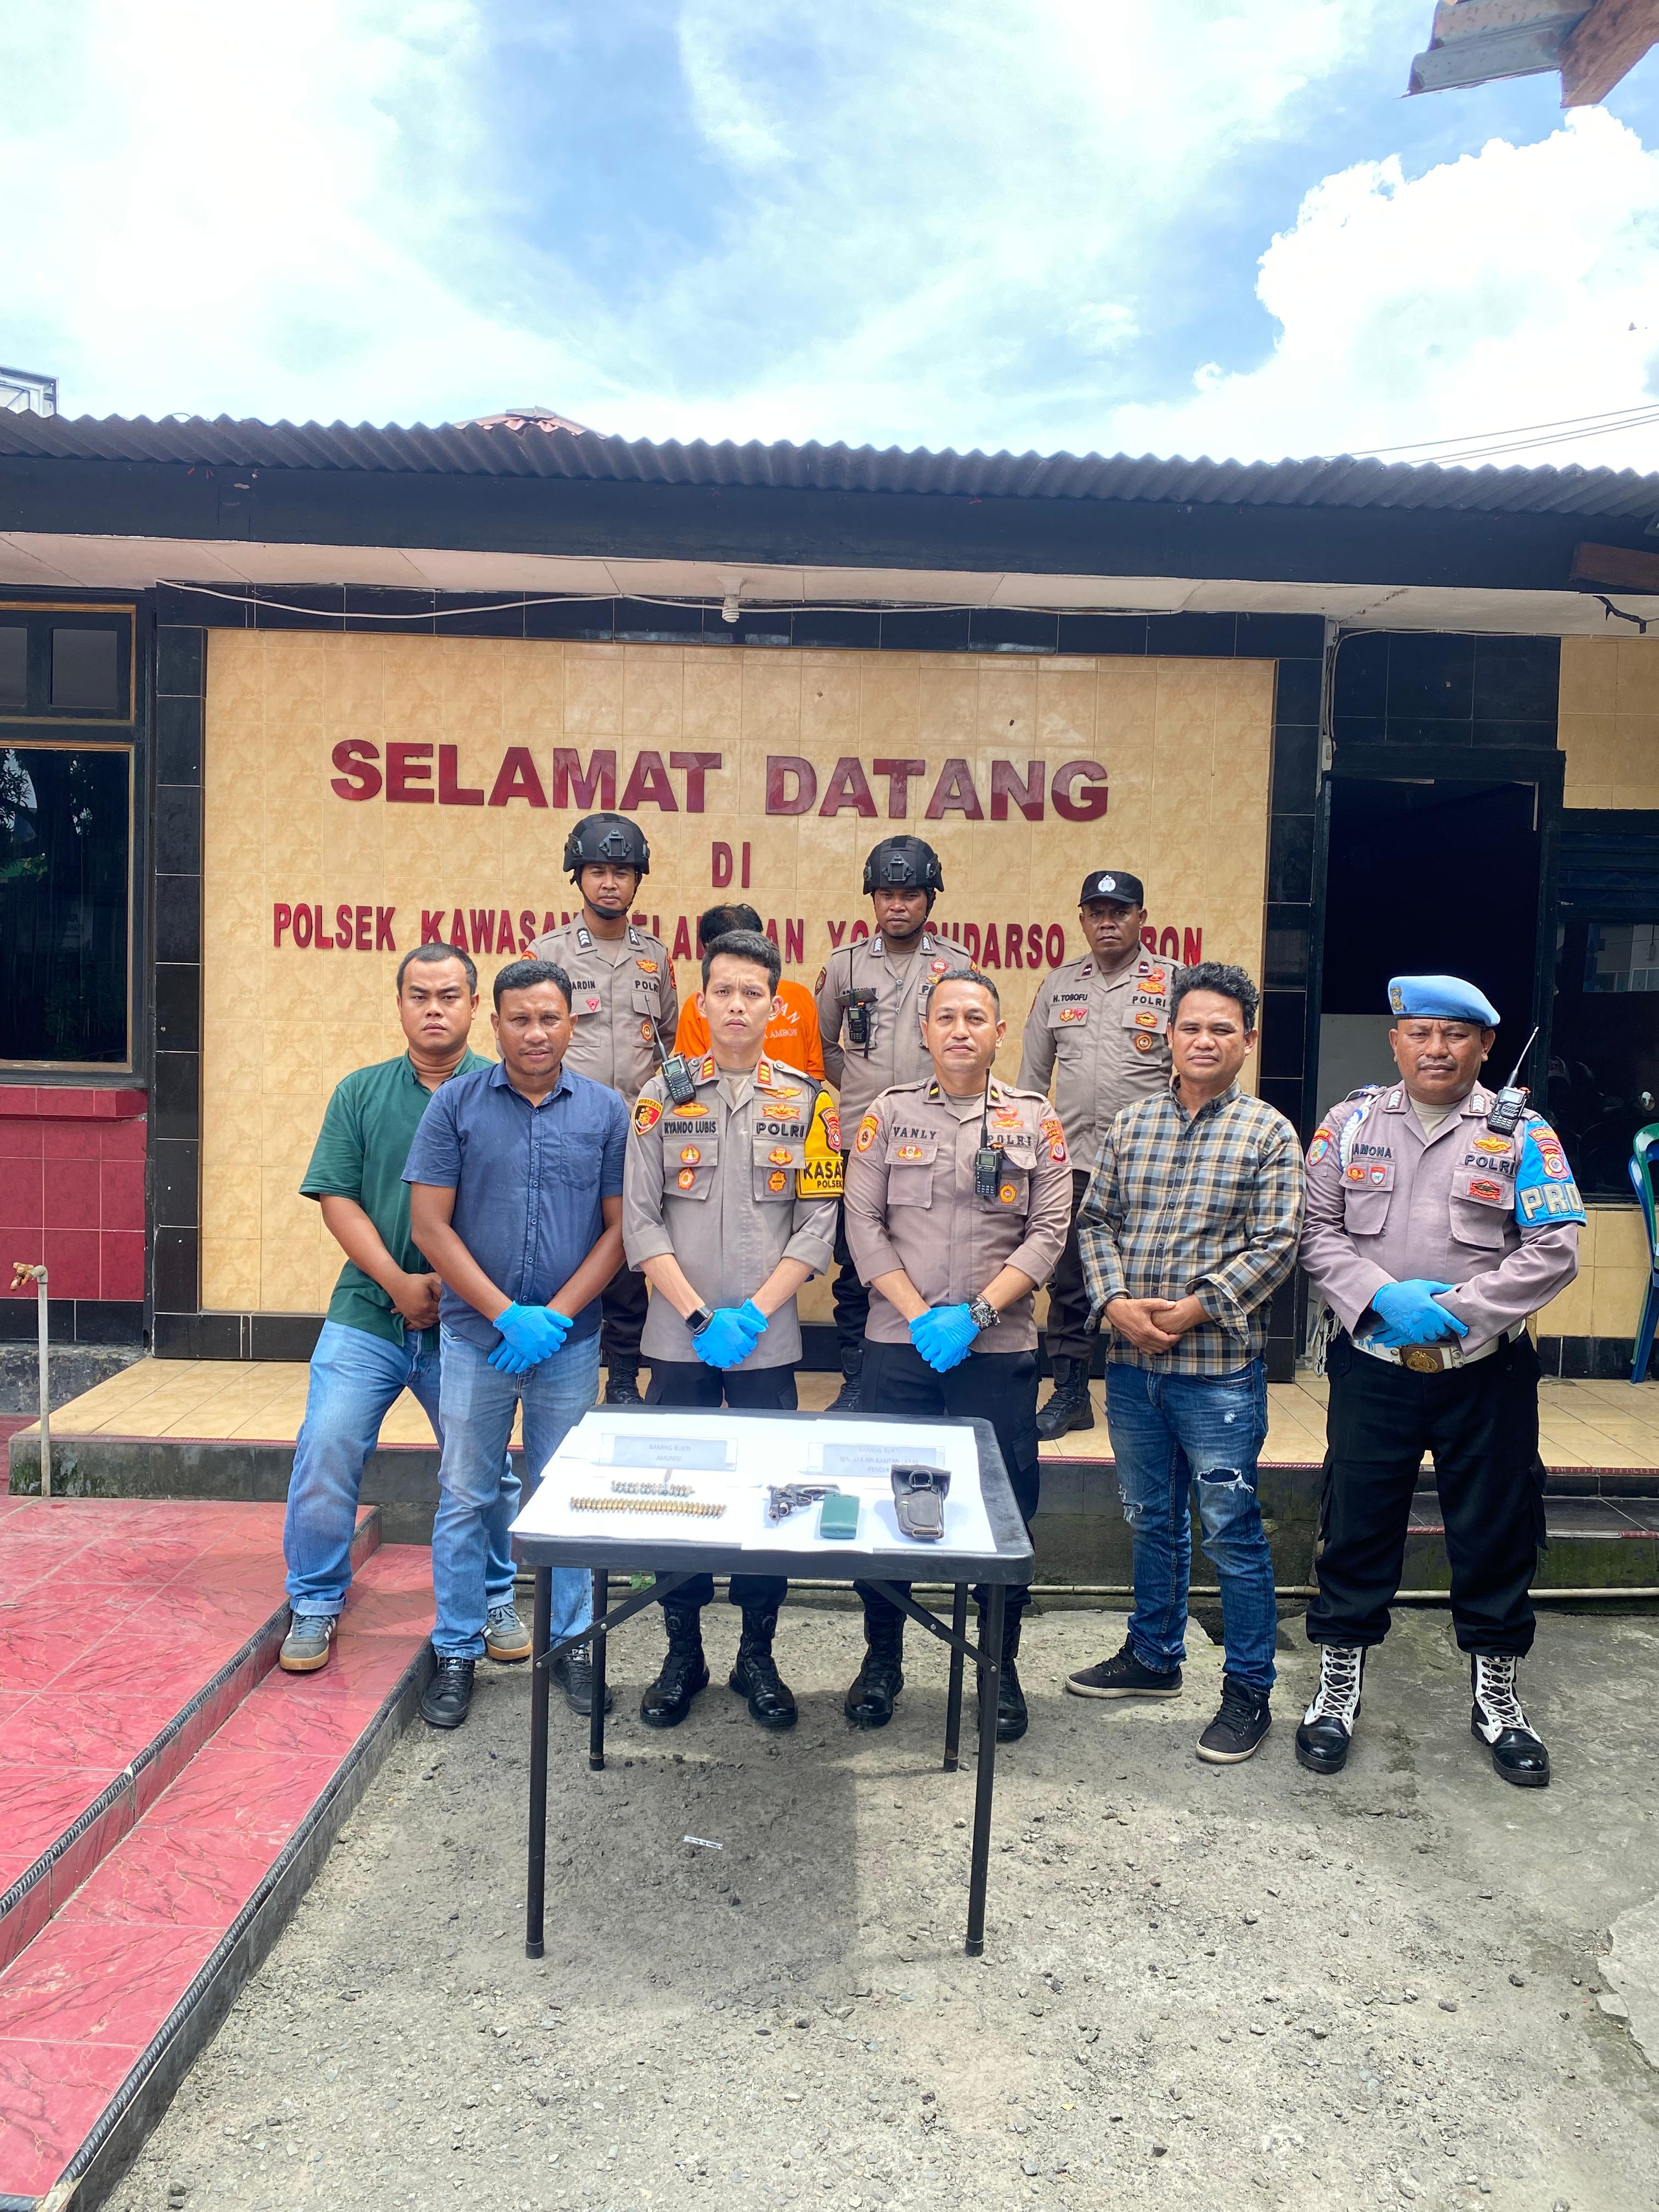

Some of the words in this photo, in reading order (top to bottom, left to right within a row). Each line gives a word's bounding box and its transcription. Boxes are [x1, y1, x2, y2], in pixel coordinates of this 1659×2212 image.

[330, 739, 722, 813] SELAMAT
[766, 755, 1108, 822] DATANG
[712, 842, 751, 888] DI
[273, 903, 396, 951] POLSEK
[421, 909, 580, 954] KAWASA
[1140, 926, 1202, 966] BON
[570, 980, 596, 990] ARDIN
[1132, 996, 1166, 1007] POLRI
[769, 1029, 798, 1039] AMBON
[664, 1121, 693, 1134] RYANDO
[695, 1121, 716, 1133] LUBIS
[757, 1122, 804, 1138] POLRI
[893, 1126, 937, 1140] VANLY
[1352, 1143, 1392, 1158] AMONA
[1465, 1154, 1515, 1174] POLRI
